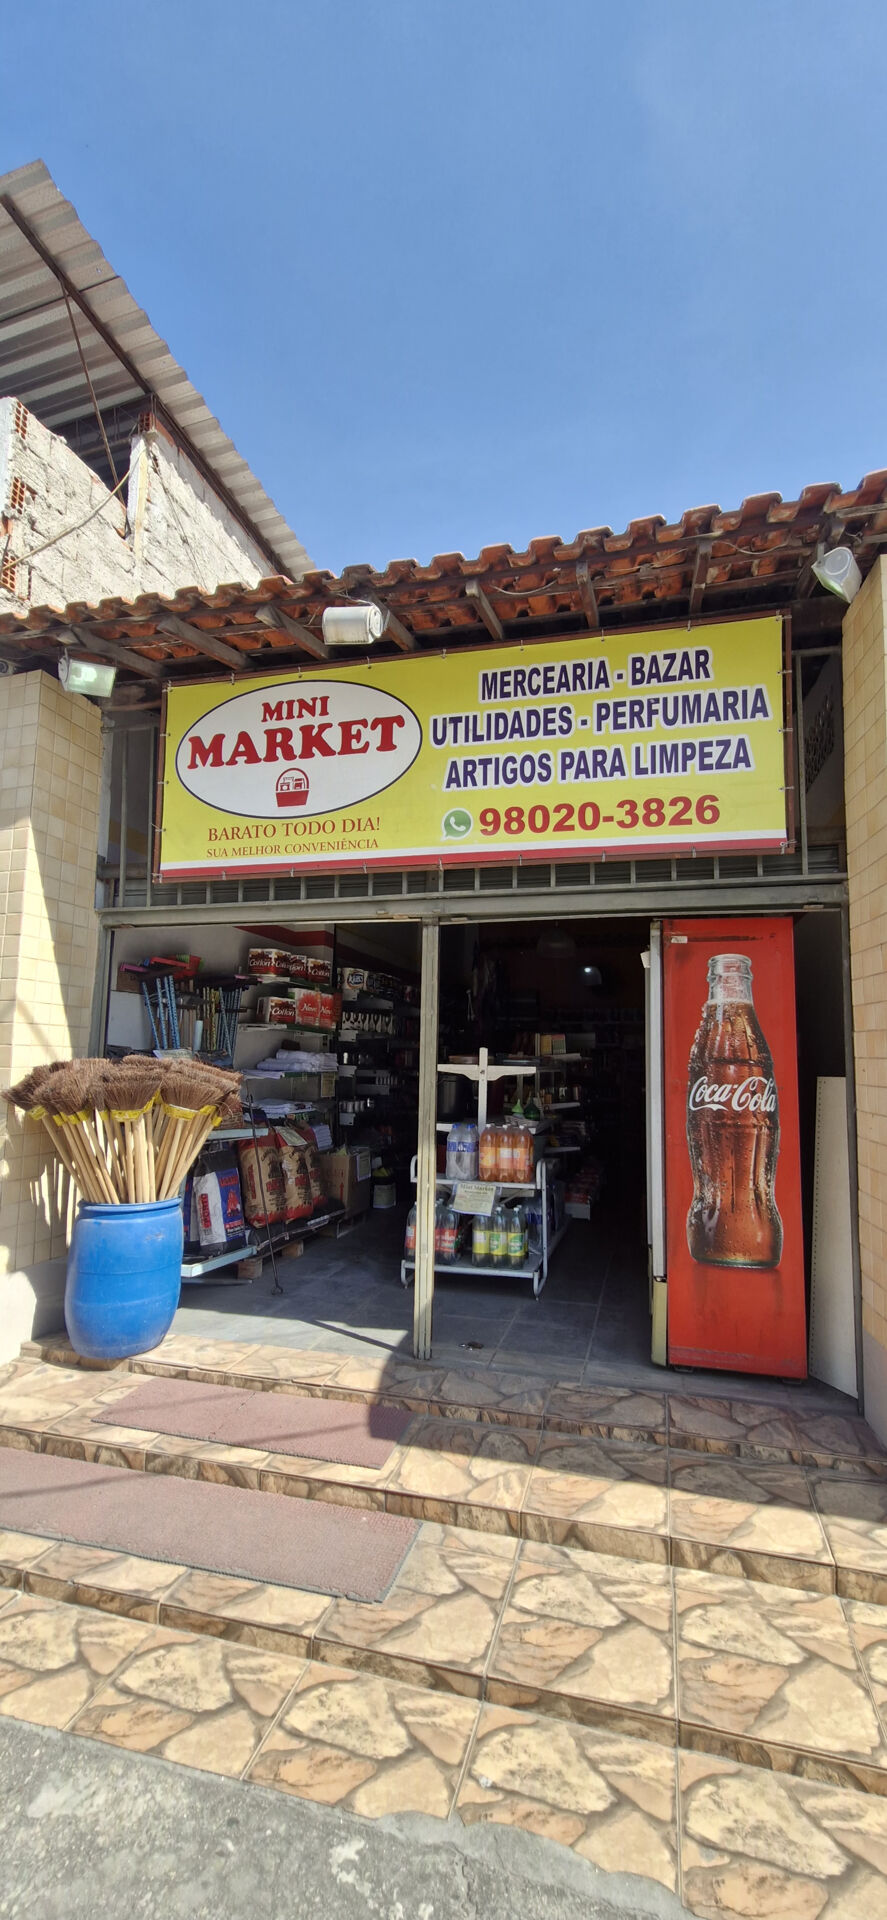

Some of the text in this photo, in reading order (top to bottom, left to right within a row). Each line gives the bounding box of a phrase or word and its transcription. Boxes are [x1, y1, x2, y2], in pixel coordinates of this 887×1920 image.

[481, 660, 610, 701] MERCEARIA
[631, 649, 711, 686] BAZAR
[261, 696, 330, 723] MINI
[432, 705, 572, 746] UTILIDADES
[596, 687, 769, 732] PERFUMARIA
[187, 714, 405, 769] MARKET
[445, 737, 751, 789] ARTIGOS PARA LIMPEZA
[207, 817, 381, 842] BARATO TODO DIA!
[479, 794, 721, 836] 98020-3826
[207, 837, 378, 858] SUA MELHOR CONVENIÊNCIA
[272, 1007, 295, 1016] Cotton
[689, 1075, 777, 1112] Coca-Cola
